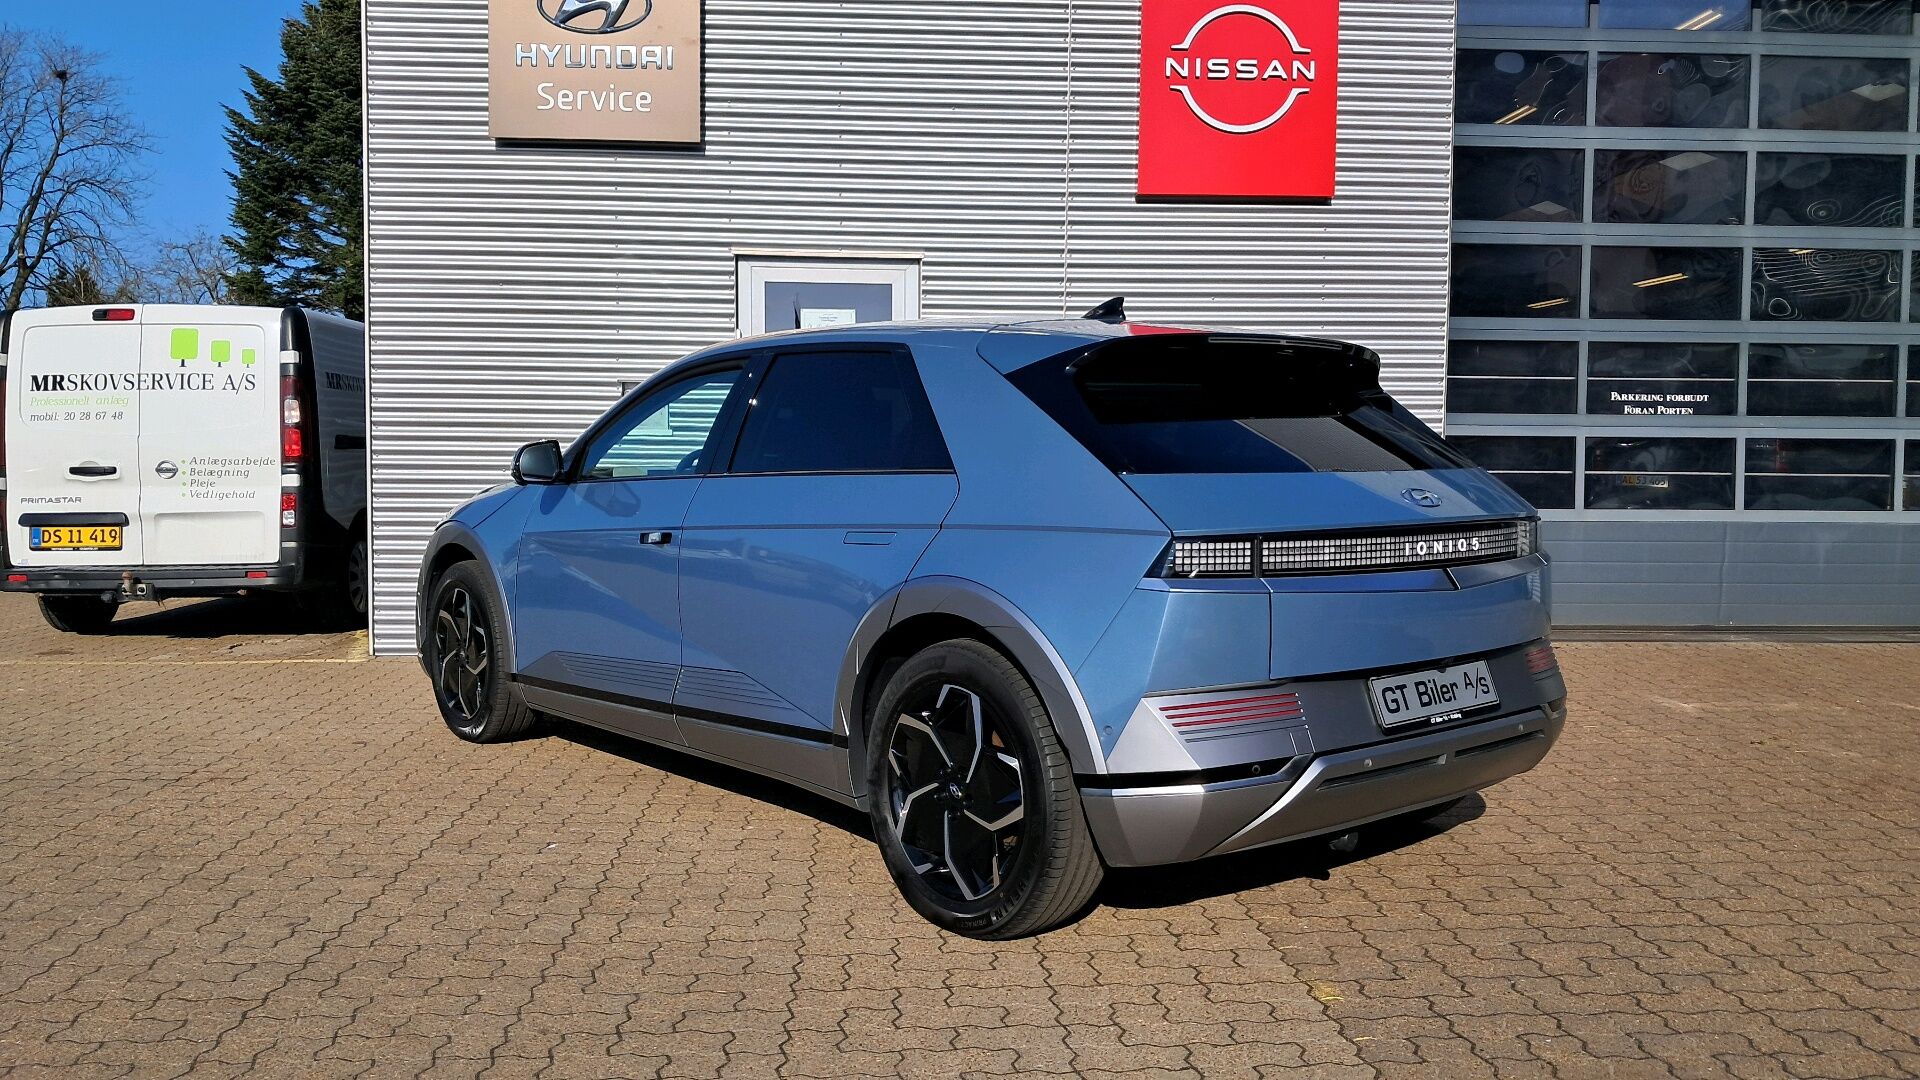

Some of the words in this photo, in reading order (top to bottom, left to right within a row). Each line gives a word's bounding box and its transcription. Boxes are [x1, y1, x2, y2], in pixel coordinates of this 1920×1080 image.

[515, 43, 674, 70] HYUNDAI
[1165, 57, 1316, 80] NISSAN
[536, 82, 653, 112] Service
[30, 373, 214, 391] MRSKOVSERVICE
[222, 373, 256, 395] A/S
[30, 412, 59, 421] mobil:
[64, 412, 75, 420] 20
[79, 412, 91, 420] 28
[95, 412, 107, 420] 67
[111, 411, 124, 420] 48
[189, 457, 276, 467] Anlægsarbejde
[189, 468, 250, 478] Belægning
[190, 479, 216, 489] Pleje
[20, 496, 82, 504] PRIMASTAR
[190, 490, 256, 500] Vedligehold
[42, 529, 62, 543] DS
[68, 529, 83, 543] 11
[89, 529, 118, 543] 419
[1382, 684, 1409, 714] GT
[1414, 679, 1459, 708] Biler
